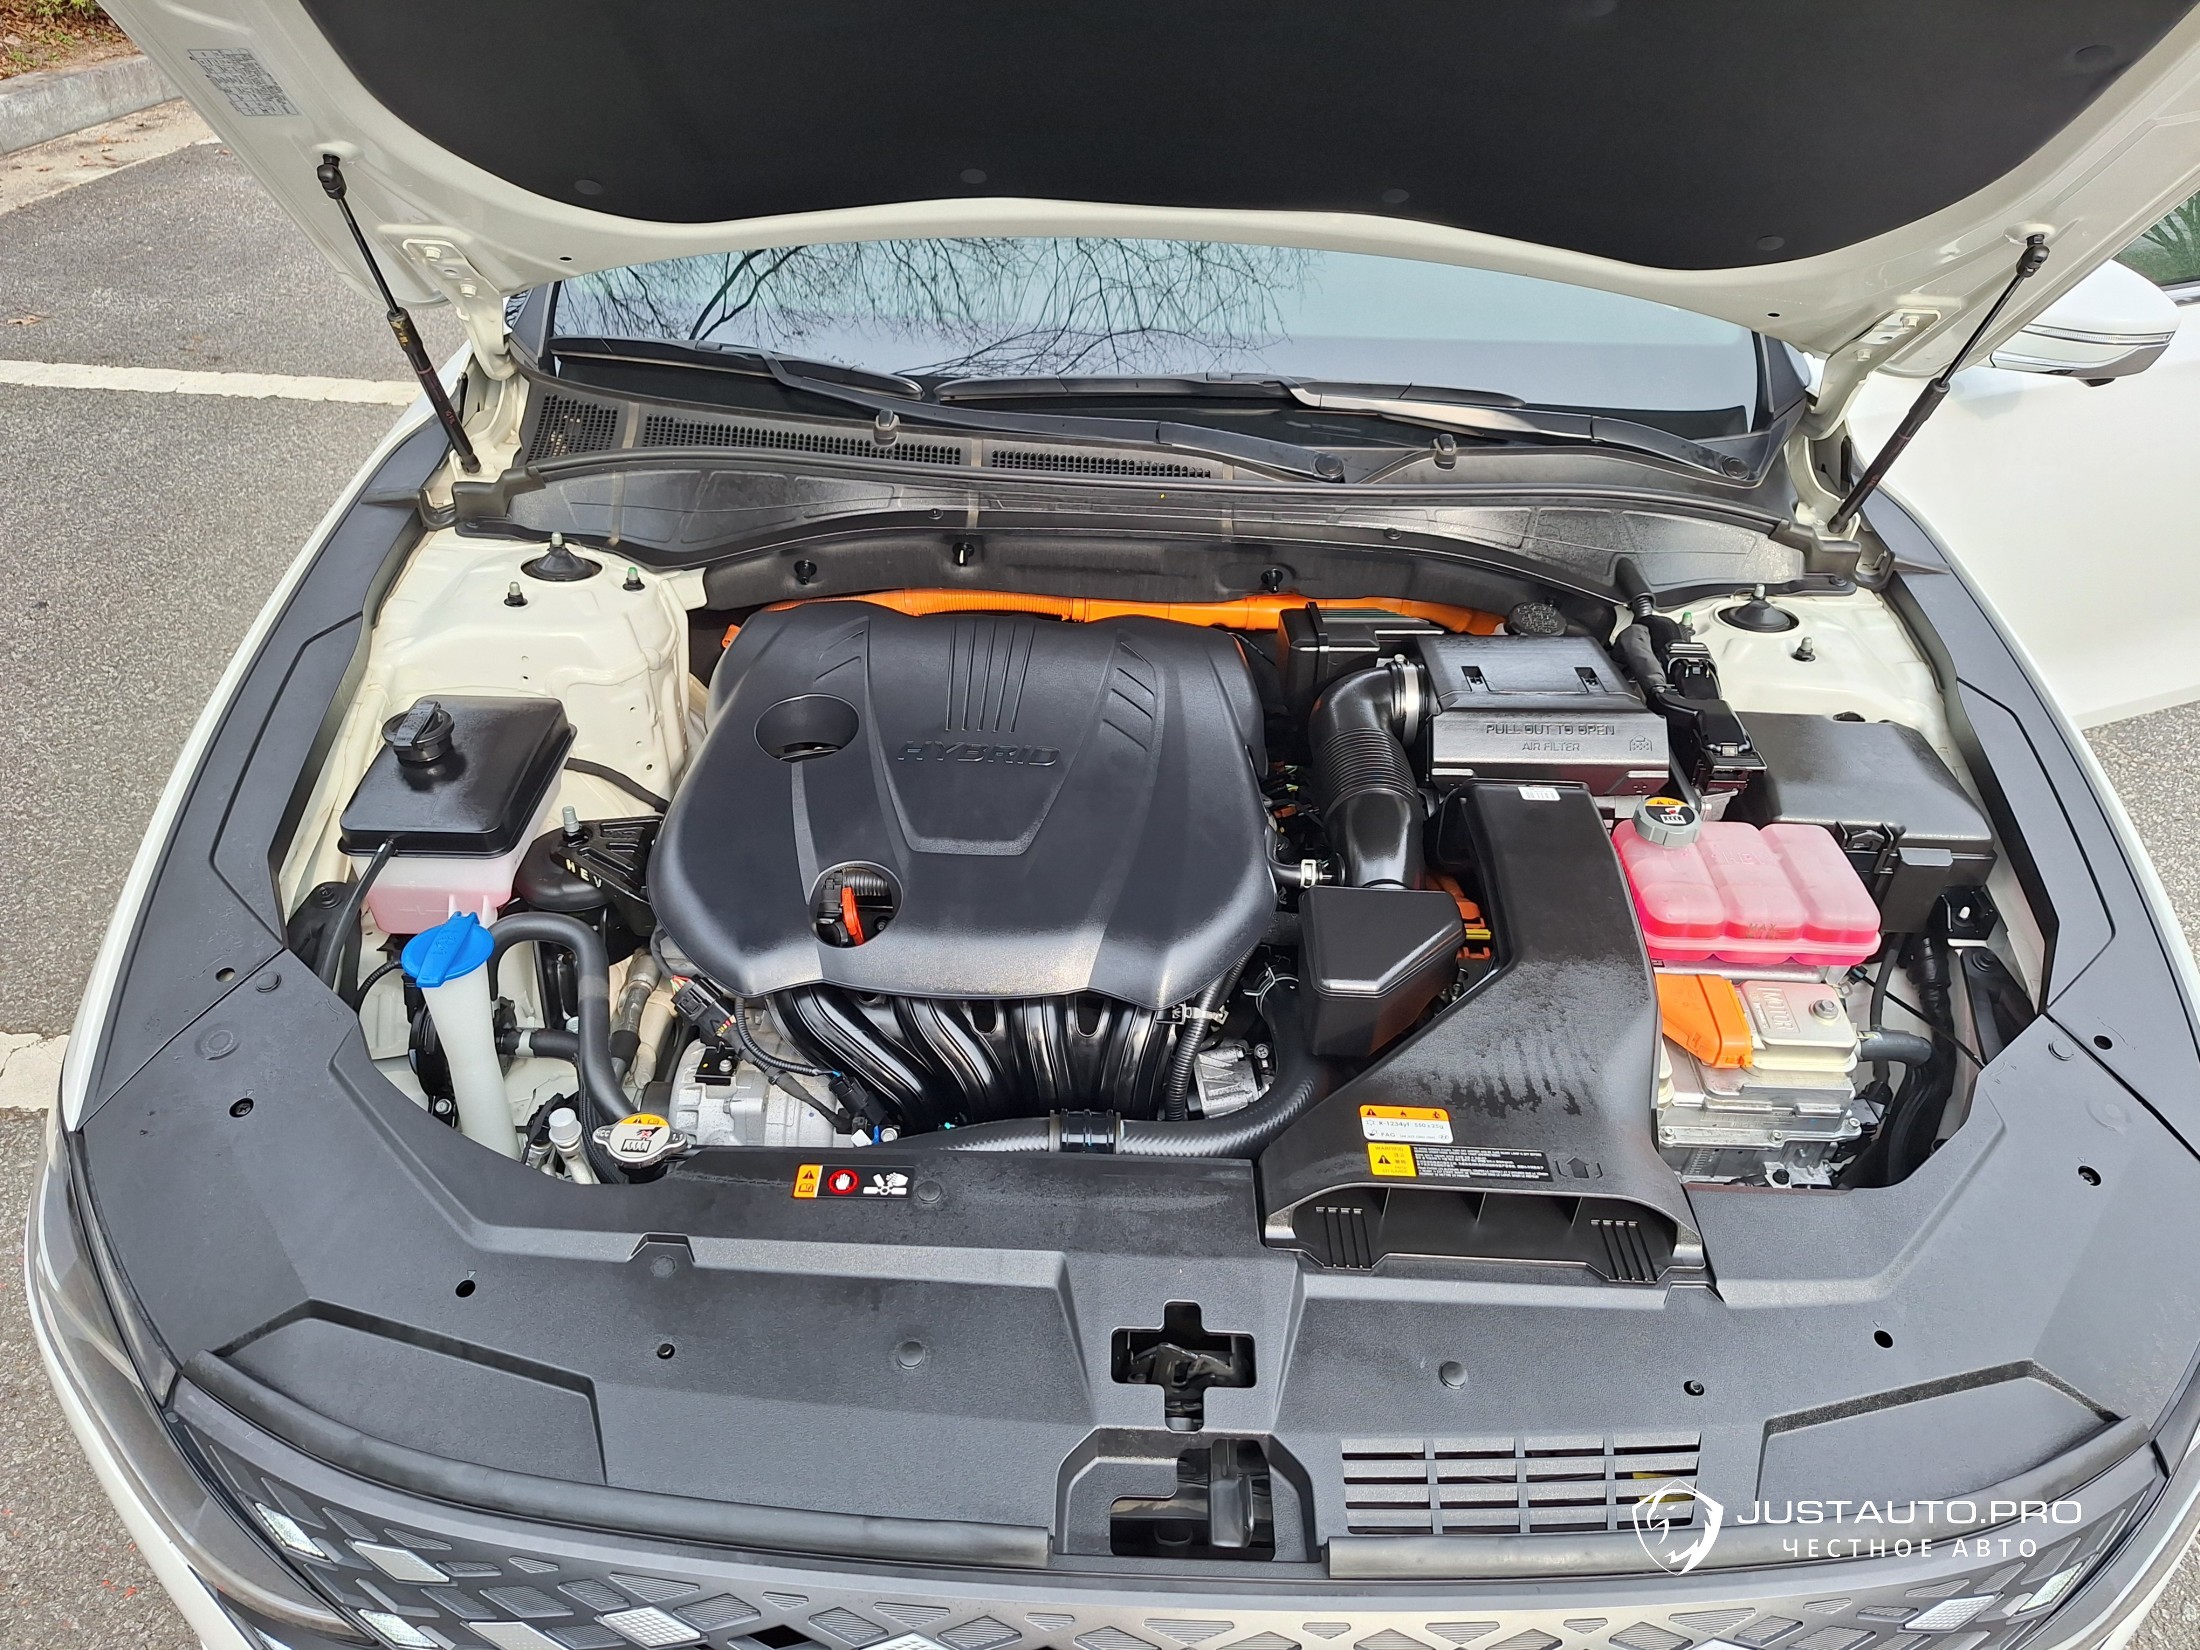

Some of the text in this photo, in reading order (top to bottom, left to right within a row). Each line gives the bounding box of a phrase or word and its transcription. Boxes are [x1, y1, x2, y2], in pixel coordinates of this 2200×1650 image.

[1485, 723, 1615, 735] PULL OUT TO OPEN
[897, 739, 1061, 766] HYBRID
[1521, 741, 1580, 751] AIR FILTER
[565, 858, 602, 888] HEV
